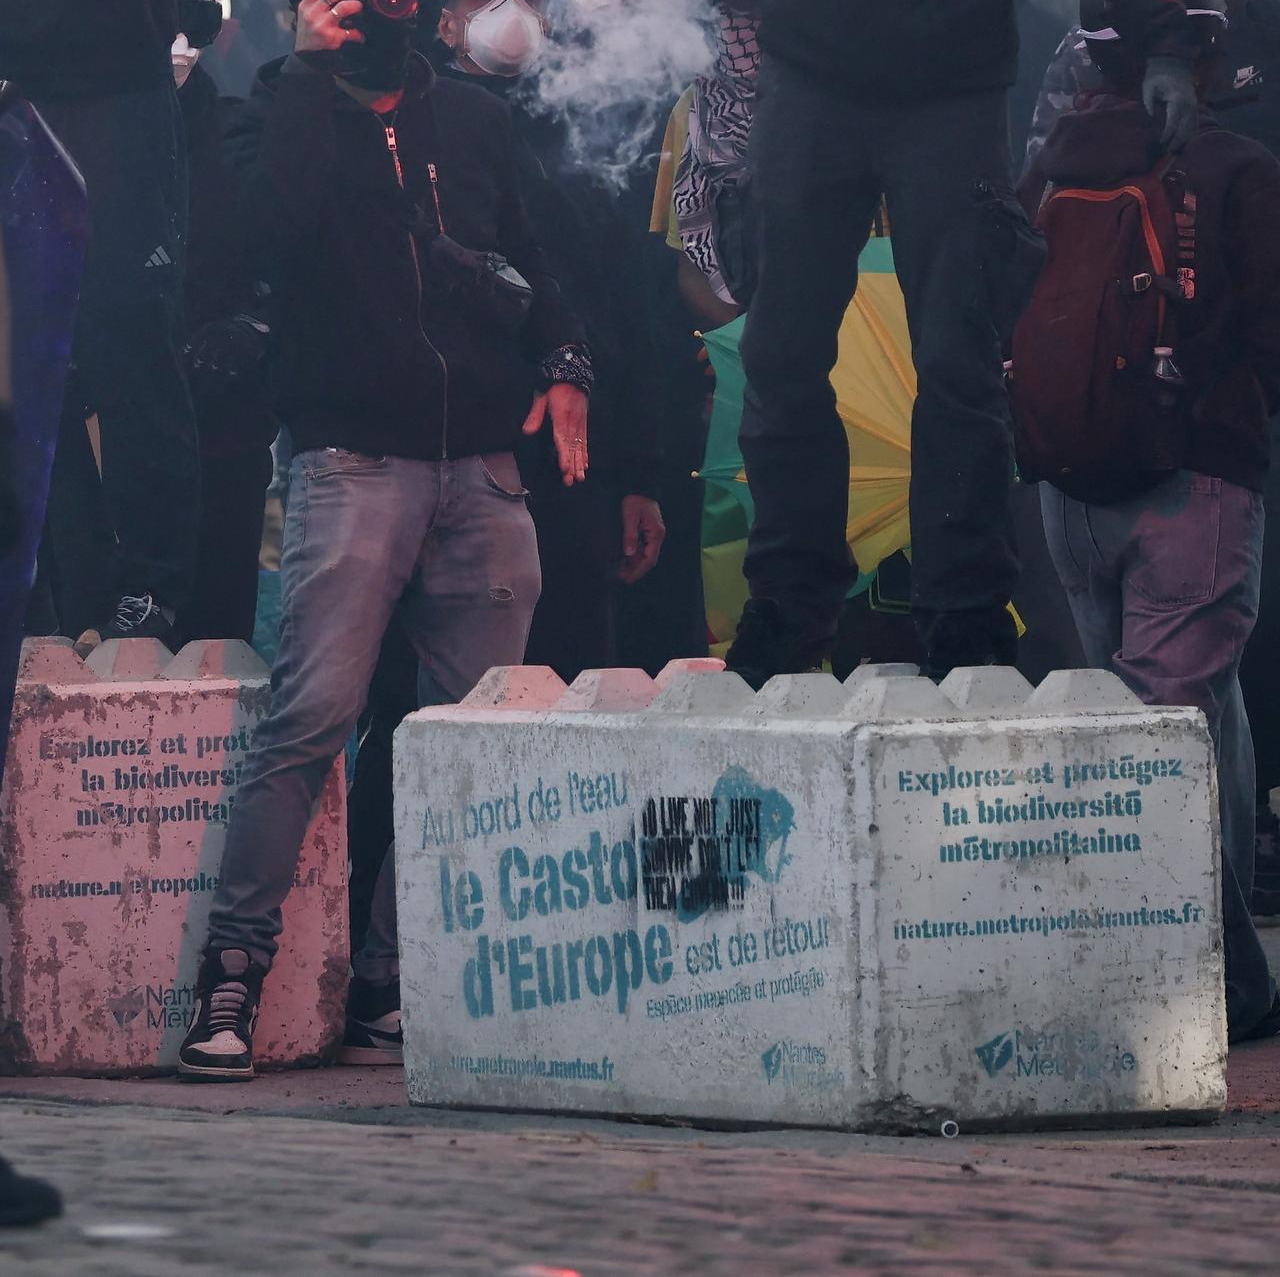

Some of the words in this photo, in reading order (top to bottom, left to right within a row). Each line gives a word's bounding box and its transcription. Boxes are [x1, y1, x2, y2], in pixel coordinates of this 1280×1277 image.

[160, 732, 188, 755] et
[197, 727, 251, 758] prot
[81, 769, 106, 792] la
[114, 760, 244, 791] biodiversi
[898, 765, 1016, 796] Explorez
[1026, 762, 1056, 784] et
[462, 782, 522, 840] bord
[528, 776, 561, 822] de
[942, 801, 968, 826] la
[440, 854, 485, 934] le
[499, 830, 638, 922] Casto
[463, 923, 675, 1019] d'Europe
[685, 933, 722, 977] est
[728, 928, 758, 966] de
[762, 915, 831, 960] retour
